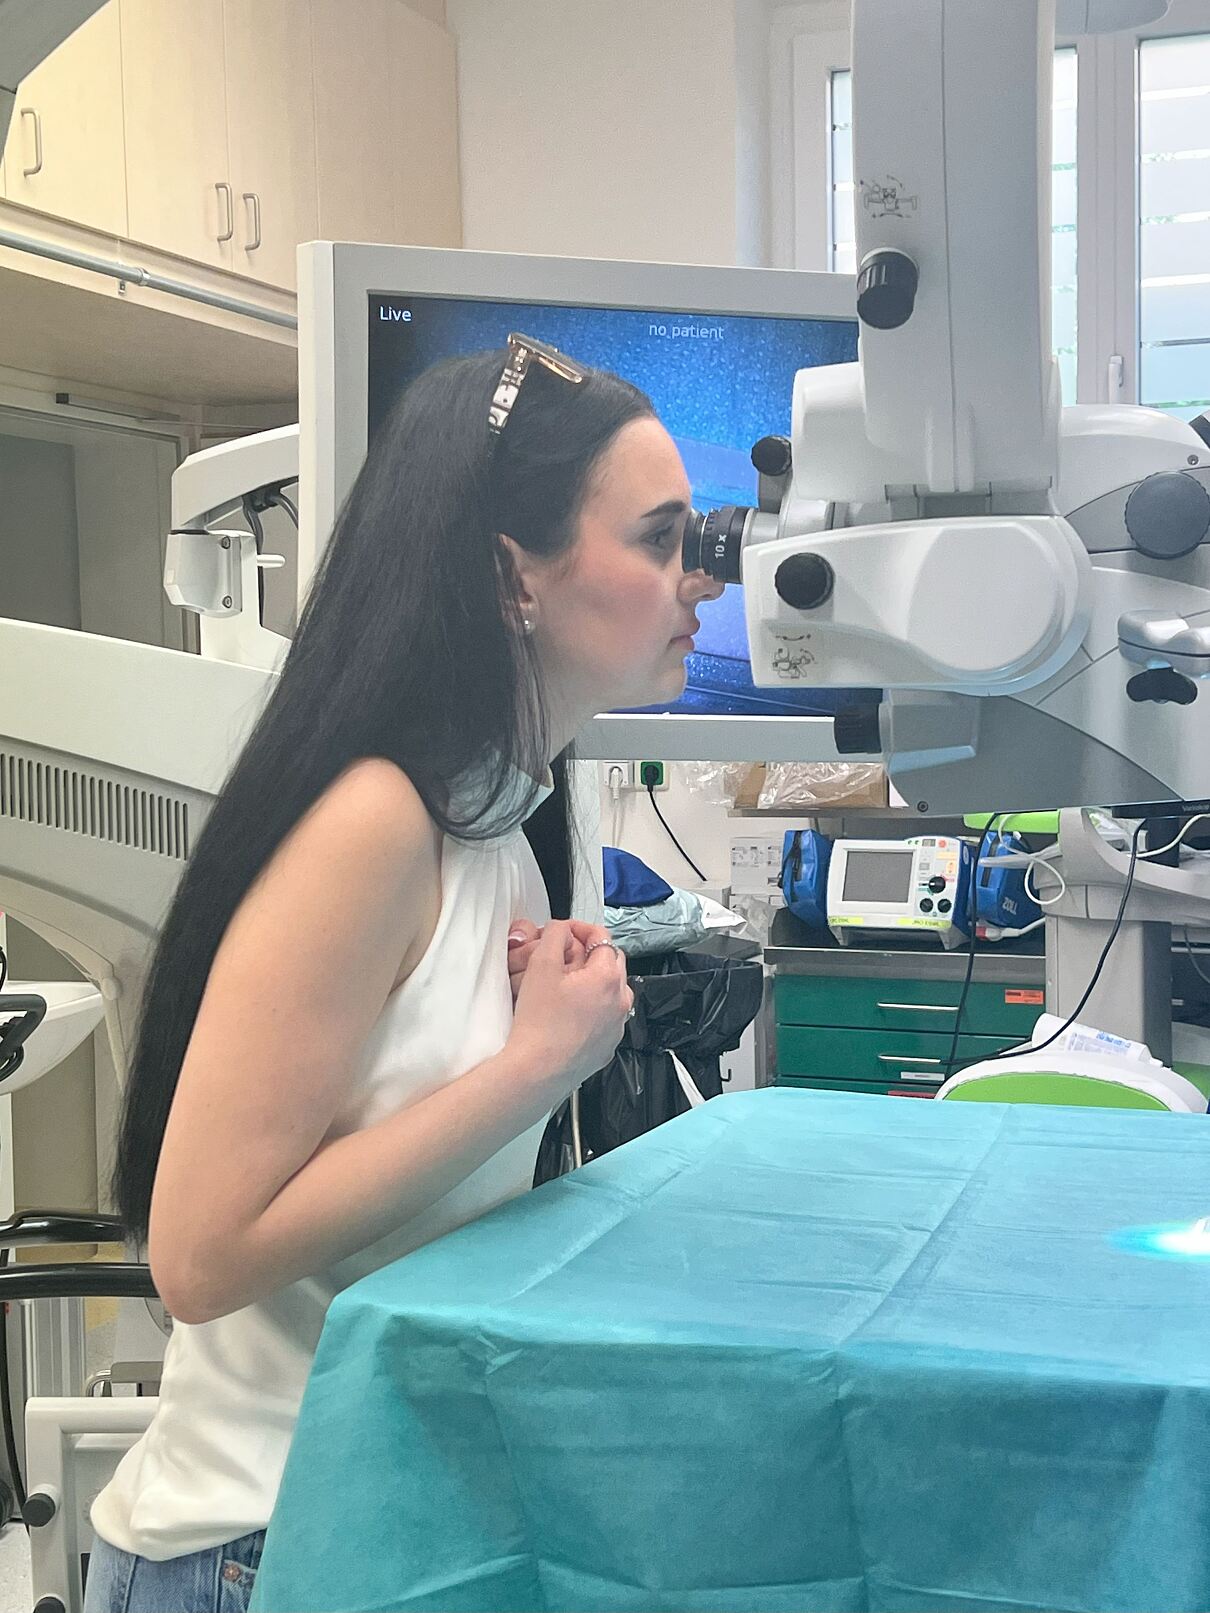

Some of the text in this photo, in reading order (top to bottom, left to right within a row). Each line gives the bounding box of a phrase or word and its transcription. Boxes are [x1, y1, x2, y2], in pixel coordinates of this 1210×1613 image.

[380, 305, 412, 322] Live
[649, 324, 725, 340] no patient
